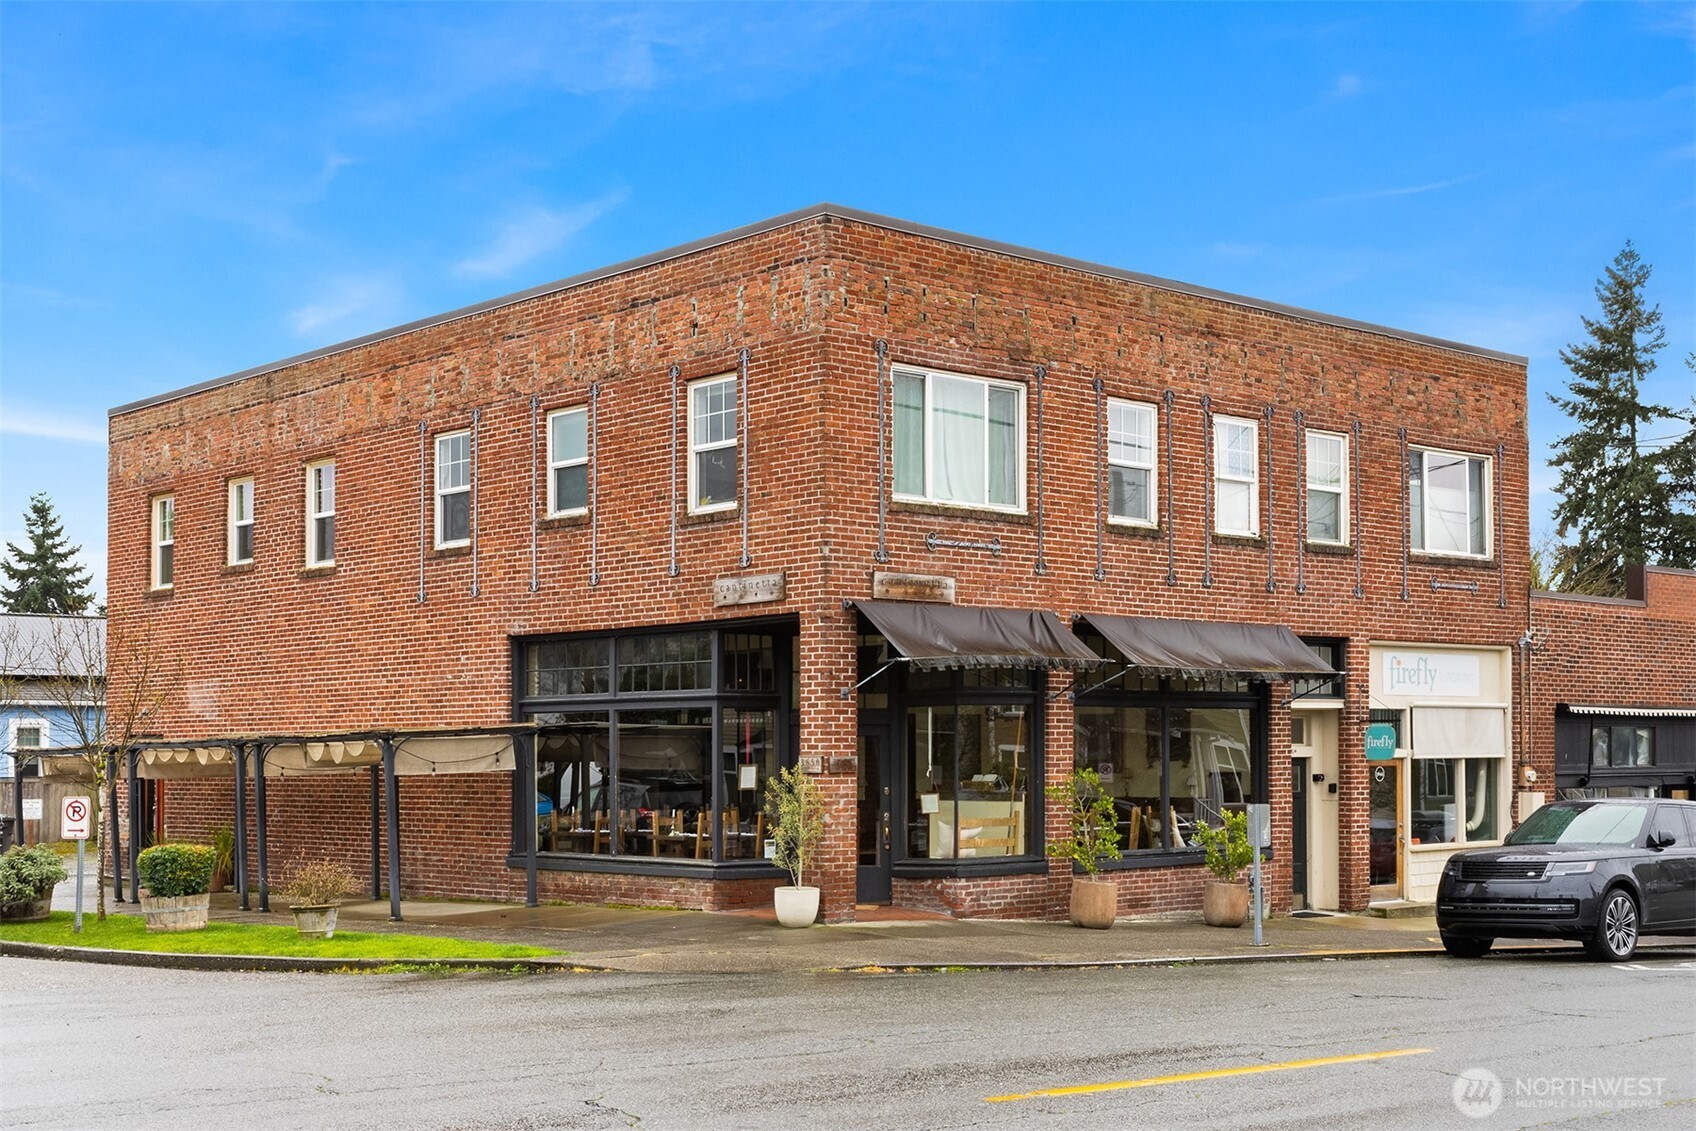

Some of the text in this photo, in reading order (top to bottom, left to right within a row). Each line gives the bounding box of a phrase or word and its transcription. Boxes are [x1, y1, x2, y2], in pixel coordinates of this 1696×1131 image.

[719, 579, 778, 593] cantinetta
[1388, 655, 1437, 692] firefly
[1367, 734, 1394, 749] firefly
